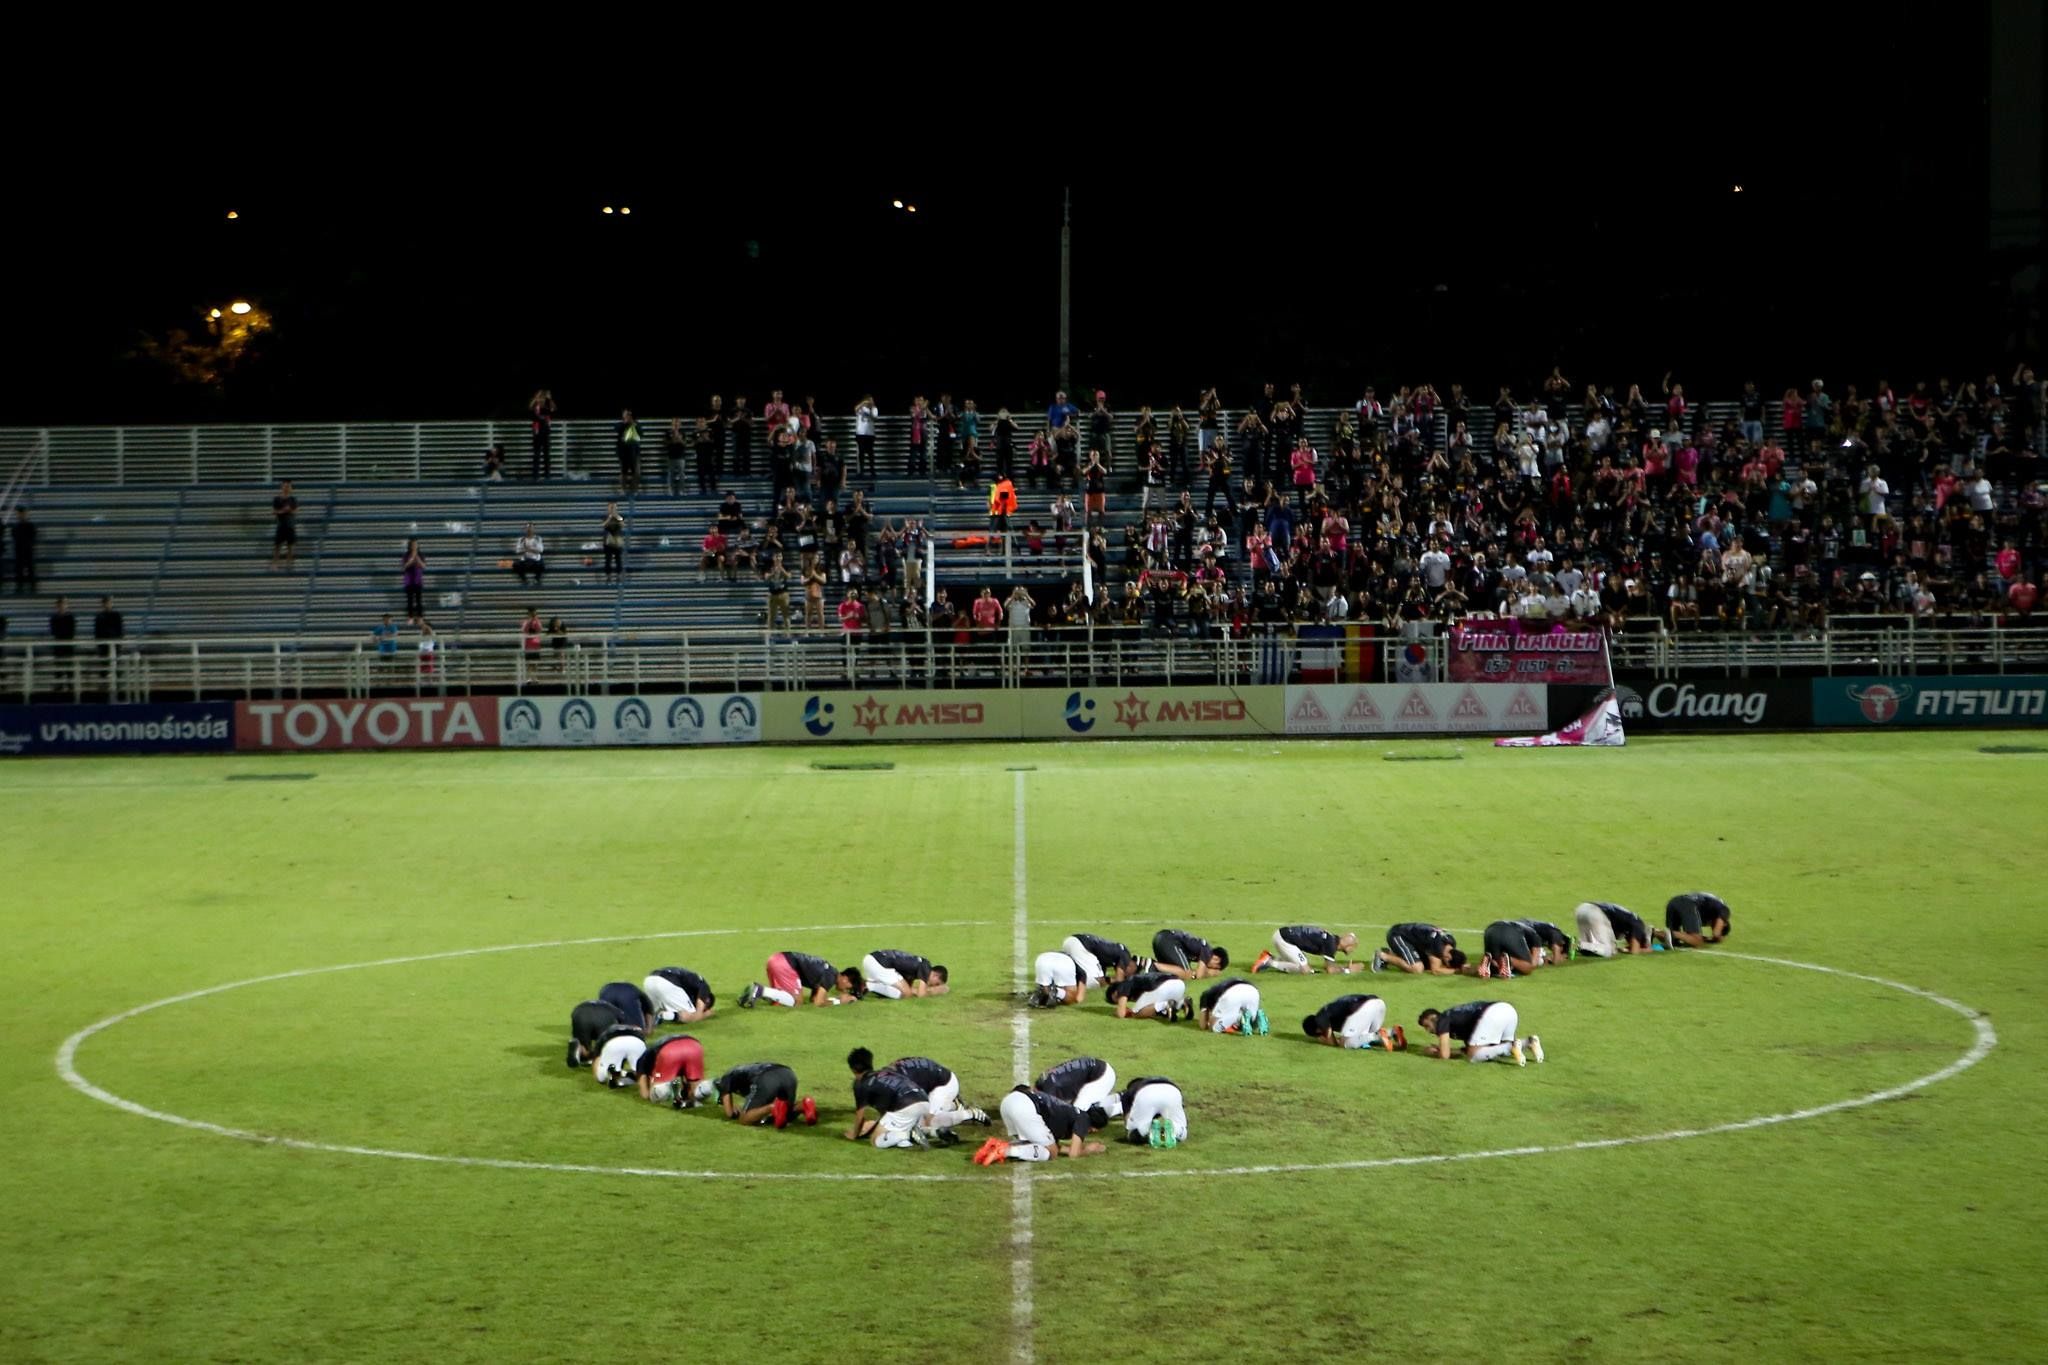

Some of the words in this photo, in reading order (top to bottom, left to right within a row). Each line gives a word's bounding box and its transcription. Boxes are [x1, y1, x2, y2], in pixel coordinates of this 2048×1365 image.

[1458, 632, 1511, 651] PINK
[1515, 632, 1602, 651] RANGER
[1647, 683, 1768, 724] Chang
[1915, 690, 2047, 715] คาราบาว
[40, 715, 229, 741] บางกอกแอร์เวย์ส
[249, 701, 485, 746] TOYOTA
